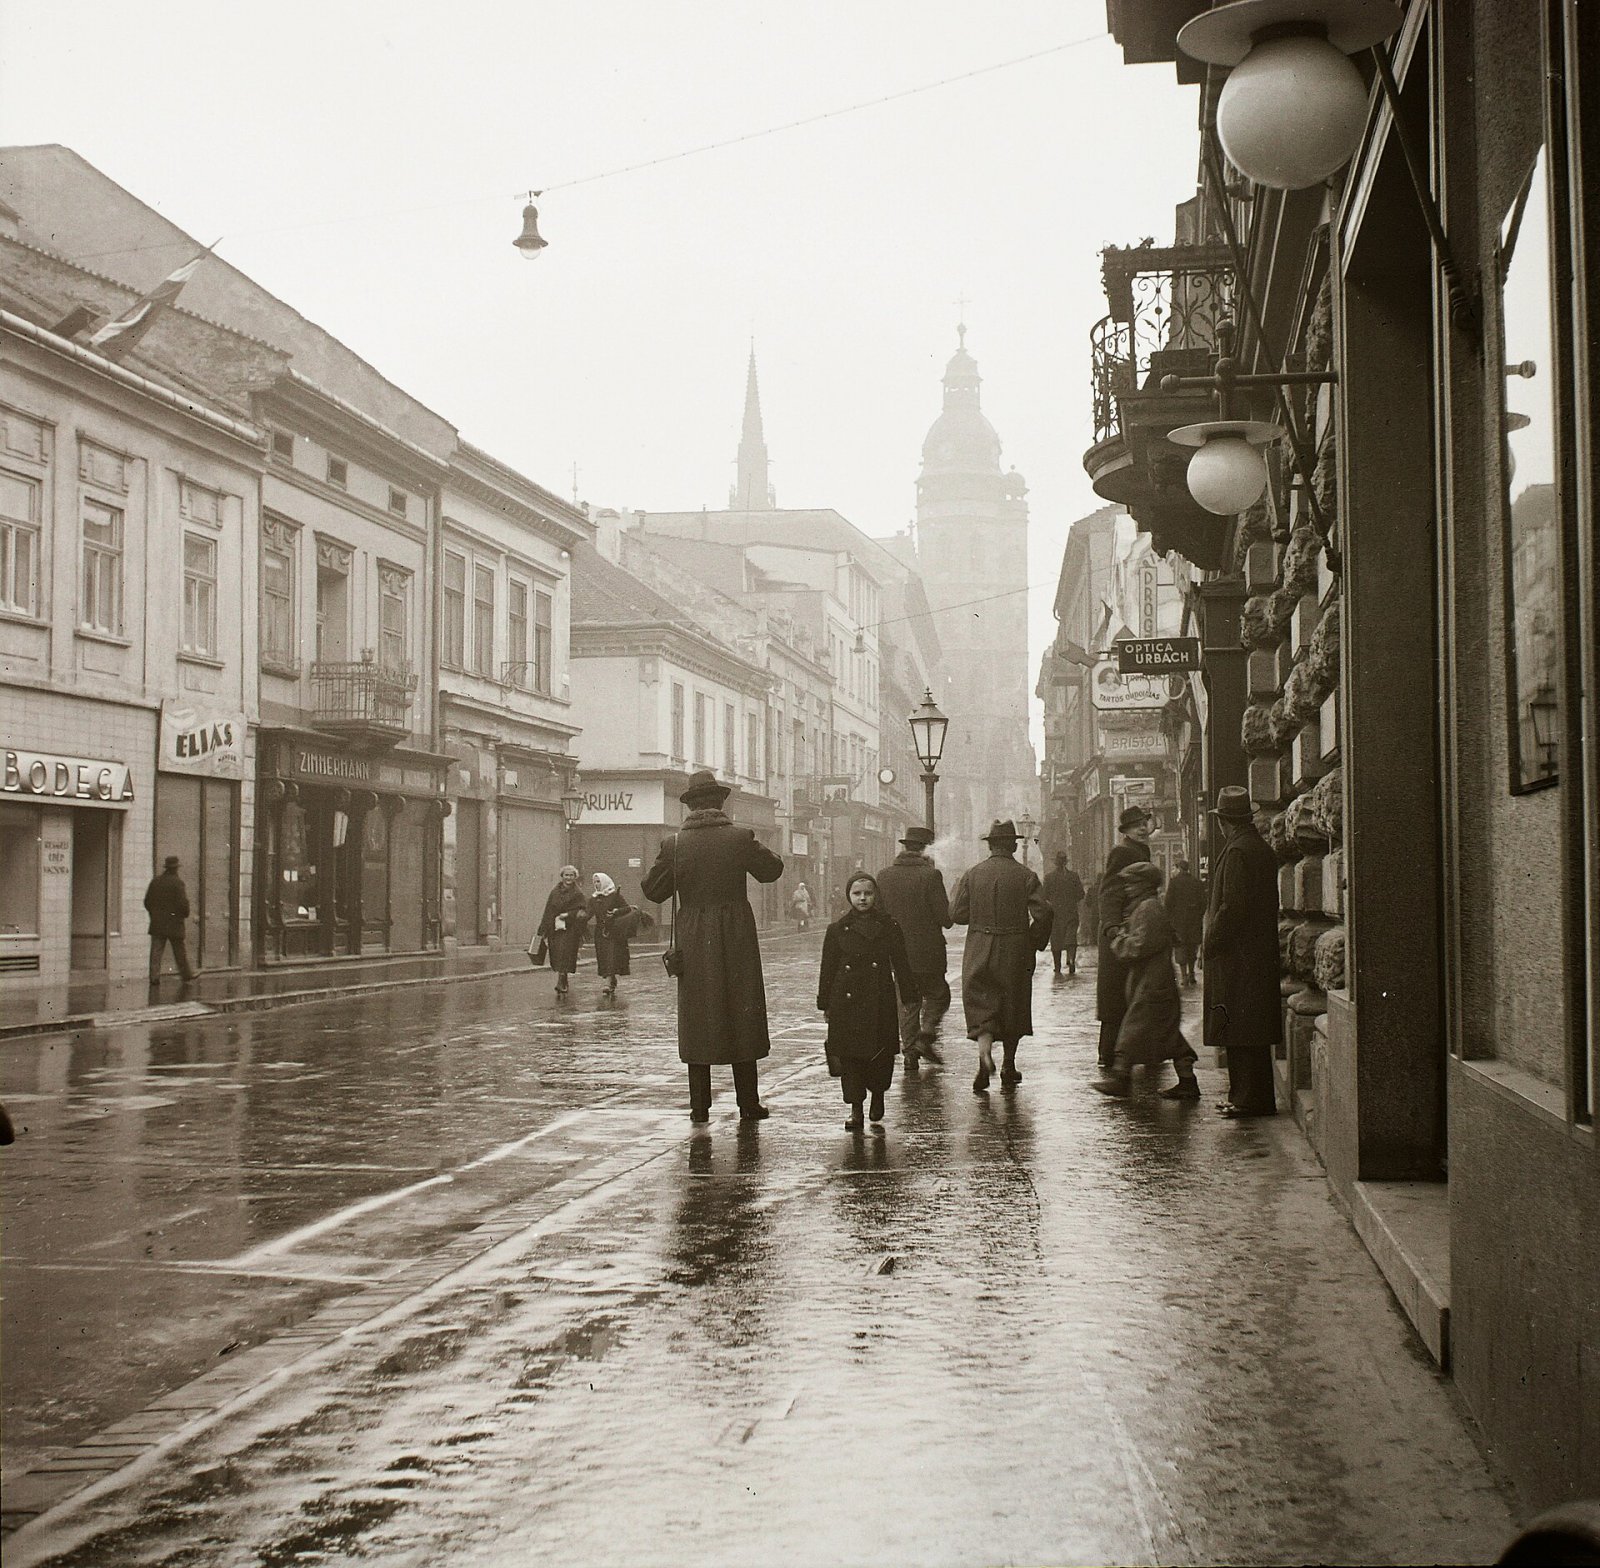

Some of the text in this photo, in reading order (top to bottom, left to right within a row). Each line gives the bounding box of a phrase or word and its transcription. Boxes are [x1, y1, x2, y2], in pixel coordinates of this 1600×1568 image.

[1125, 642, 1173, 654] OPTICA
[1135, 651, 1189, 664] URBACH
[1112, 735, 1162, 749] BRISTOL
[300, 752, 369, 780] ZIMMERMANN
[4, 751, 135, 801] BODEGA
[579, 791, 633, 811] ÁRUHÁZ
